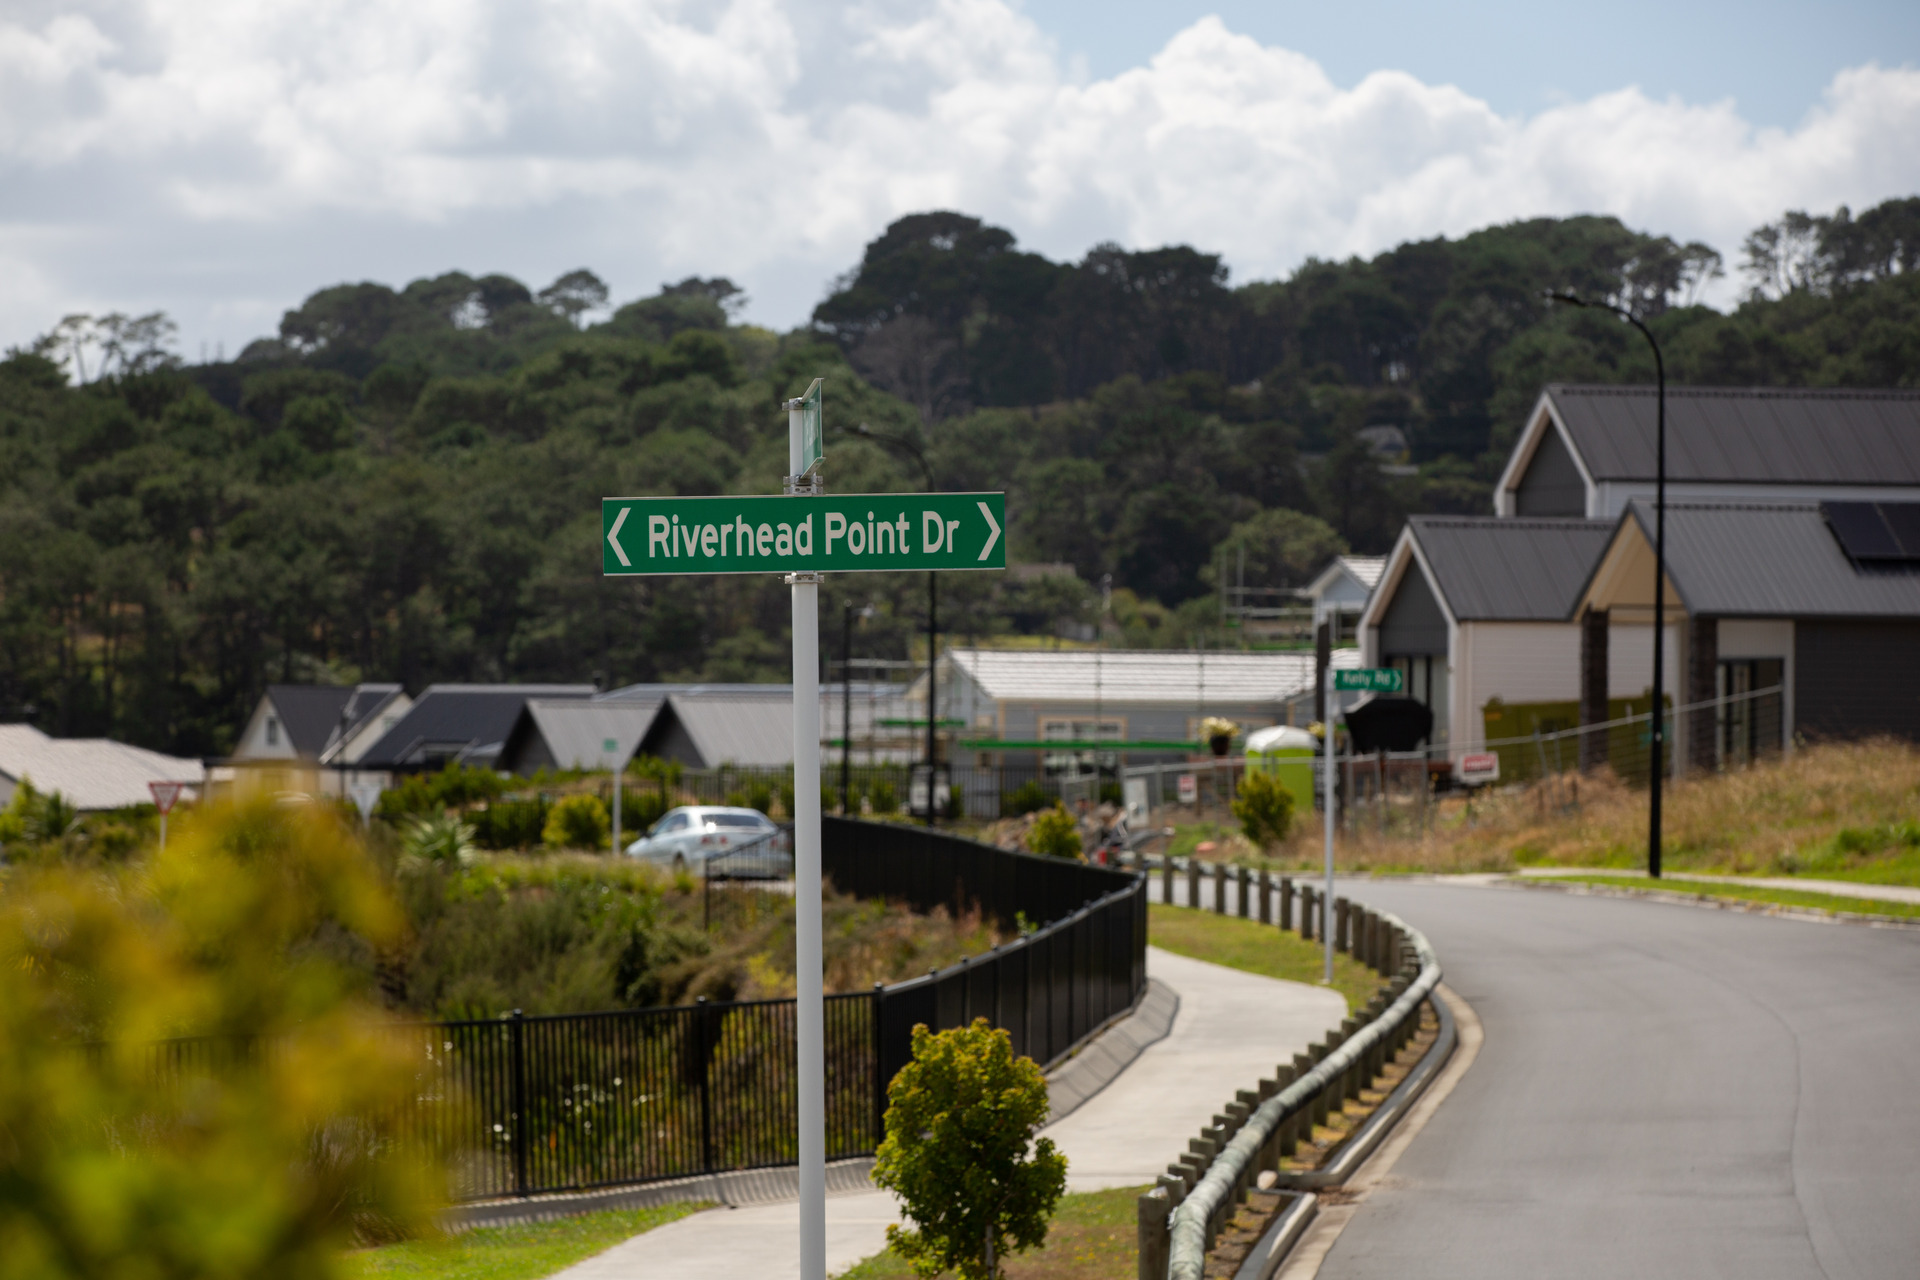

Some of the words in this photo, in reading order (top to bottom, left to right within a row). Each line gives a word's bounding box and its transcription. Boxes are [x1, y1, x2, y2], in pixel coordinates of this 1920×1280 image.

[648, 512, 813, 558] Riverhead
[825, 510, 910, 555] Point
[922, 510, 960, 554] Dr
[1375, 670, 1391, 686] Rd
